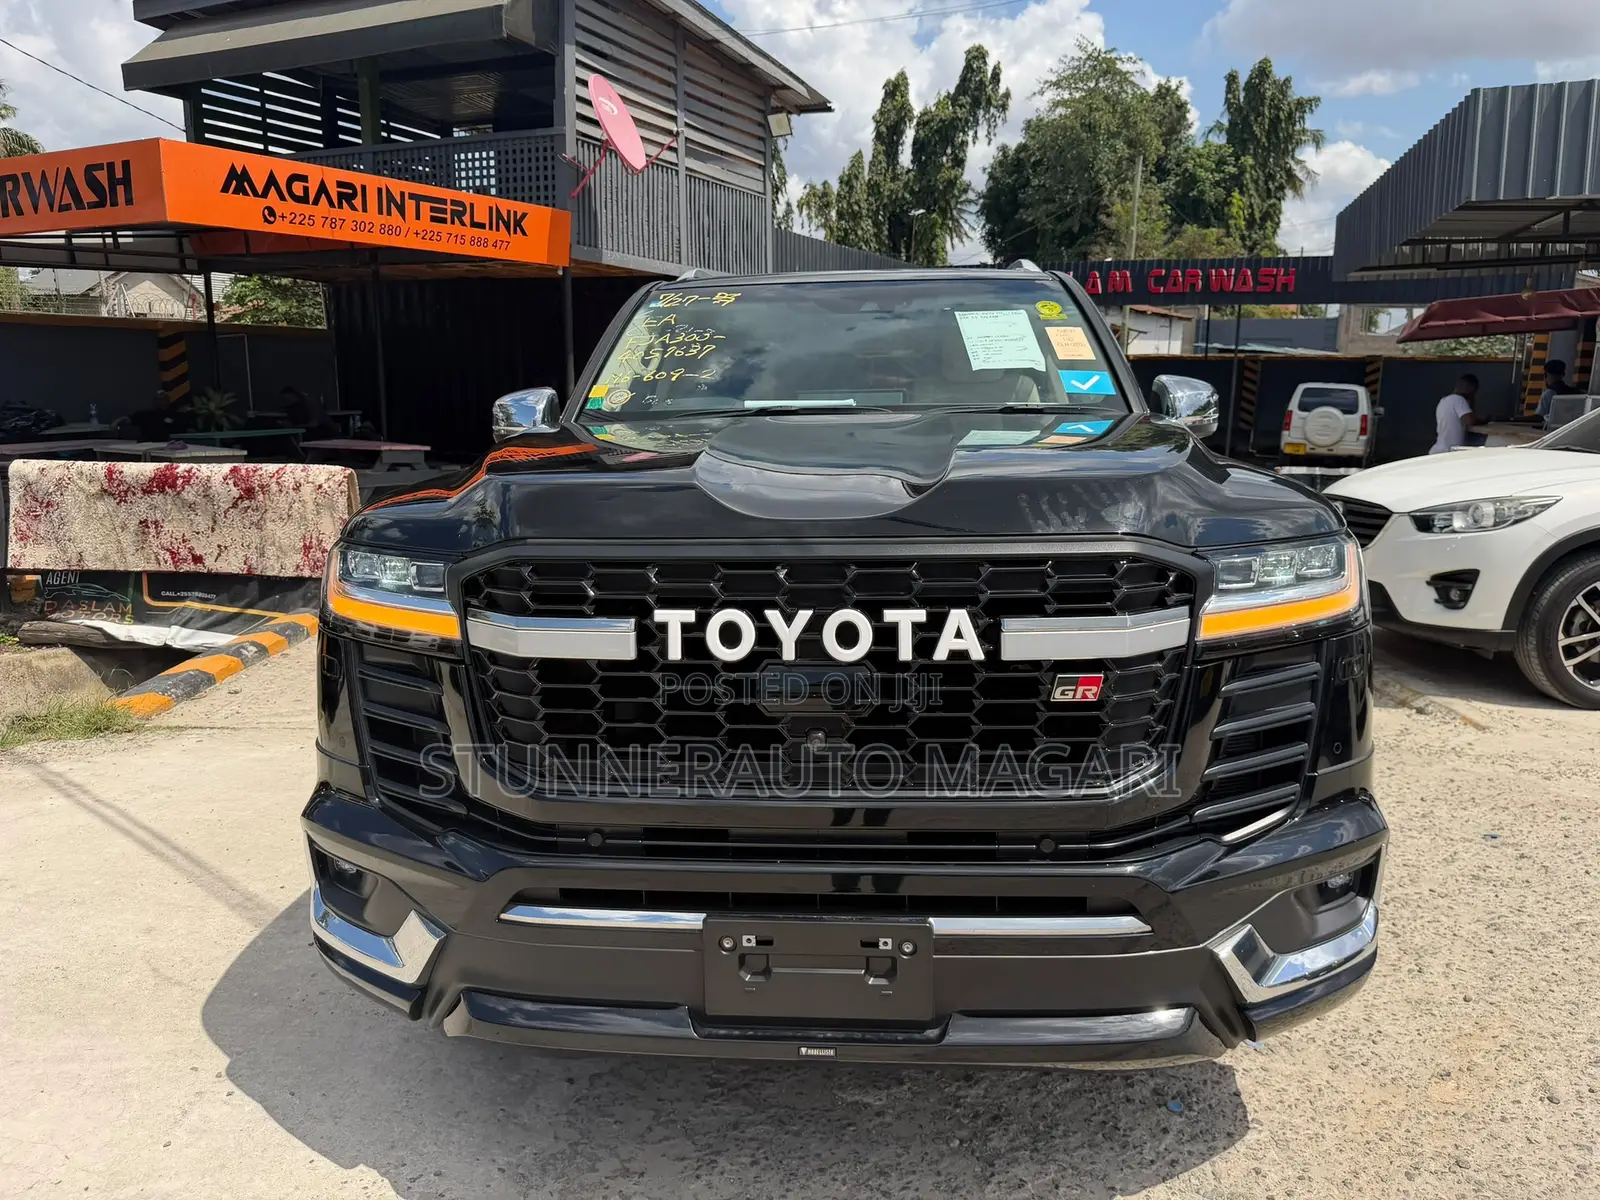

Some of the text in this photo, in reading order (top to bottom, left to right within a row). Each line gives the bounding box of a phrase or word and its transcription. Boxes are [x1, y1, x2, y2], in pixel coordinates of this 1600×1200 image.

[0, 160, 134, 218] RWASH
[220, 162, 529, 237] MAGARI INTERLINK
[278, 211, 315, 227] +225
[321, 216, 347, 230] 787
[351, 220, 375, 233] 302
[379, 223, 402, 237] 880
[413, 229, 442, 242] +225
[446, 232, 466, 246] 715
[469, 236, 489, 249] 888
[491, 239, 511, 251] 477
[1066, 267, 1296, 294] AM CAR WASH
[46, 571, 80, 585] AGENT
[44, 600, 132, 614] DASLAM
[654, 609, 985, 662] TOYOTA
[1054, 685, 1098, 699] GR
